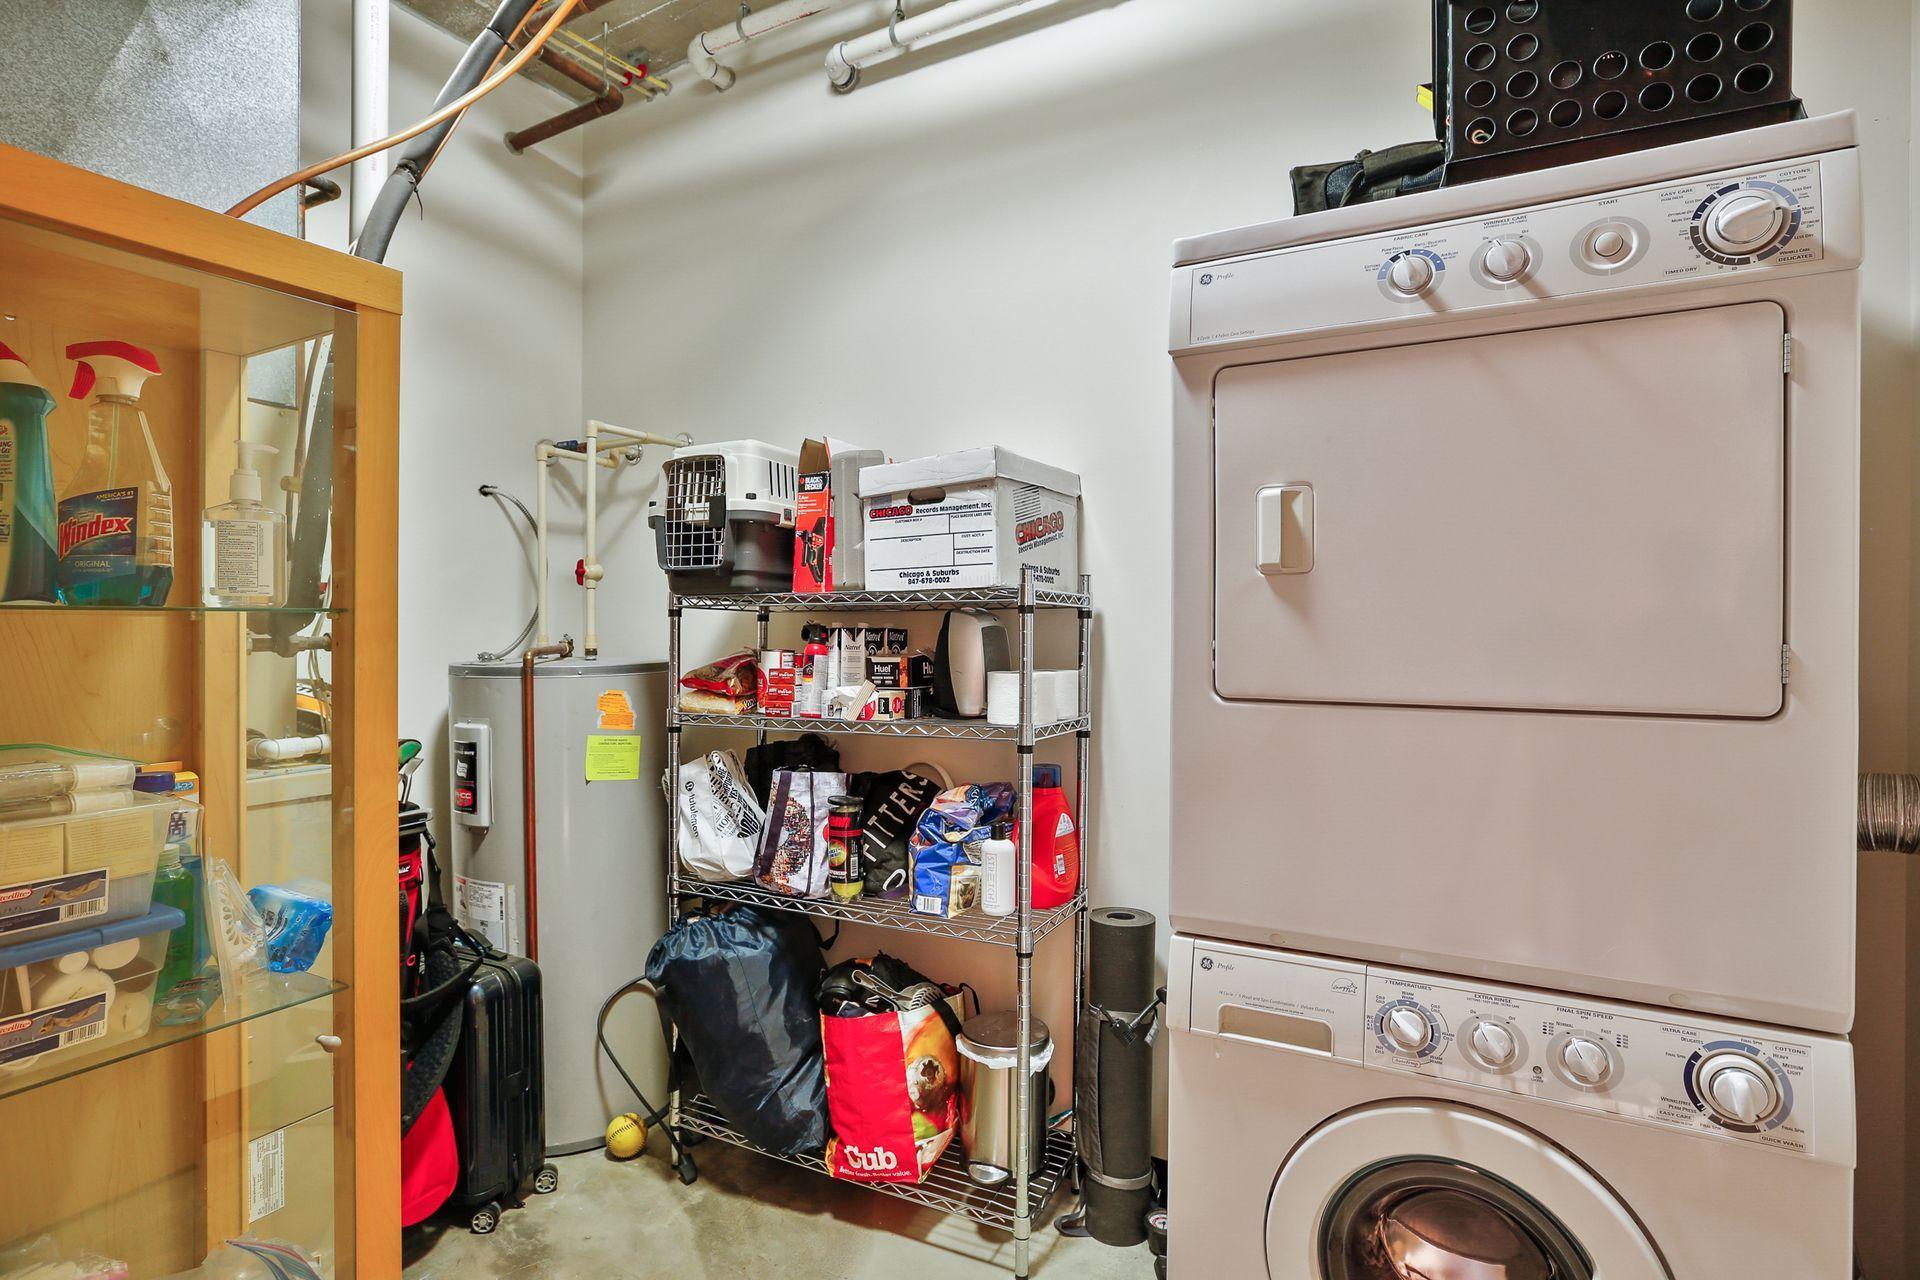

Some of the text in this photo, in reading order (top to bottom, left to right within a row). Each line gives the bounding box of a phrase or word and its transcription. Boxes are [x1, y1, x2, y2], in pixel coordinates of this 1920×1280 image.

[1660, 190, 1677, 198] EASY
[1778, 253, 1814, 262] DELICATES
[869, 505, 914, 519] CHICAGO
[915, 506, 939, 514] Records
[1015, 510, 1064, 546] CHICAGO
[58, 513, 134, 561] Windex
[74, 560, 111, 568] ORIGINAL
[899, 571, 924, 579] Chicago
[932, 569, 960, 577] Suburbs
[907, 576, 950, 585] 847-678-0002
[874, 664, 893, 673] Huel
[687, 793, 699, 838] lululemon
[1216, 962, 1236, 972] Profile
[1388, 980, 1432, 991] TEMPERATURES
[1474, 993, 1512, 1004] EXTRA RINSE
[1575, 1009, 1592, 1017] SPIN
[1592, 1012, 1614, 1020] SPEED
[1681, 1029, 1698, 1037] CARE
[1774, 1045, 1806, 1056] COTTONS
[1782, 1062, 1804, 1071] MEDIUM
[1676, 1112, 1692, 1120] CARE
[1761, 1135, 1804, 1149] QUICK WASH
[844, 1145, 898, 1171] Cub
